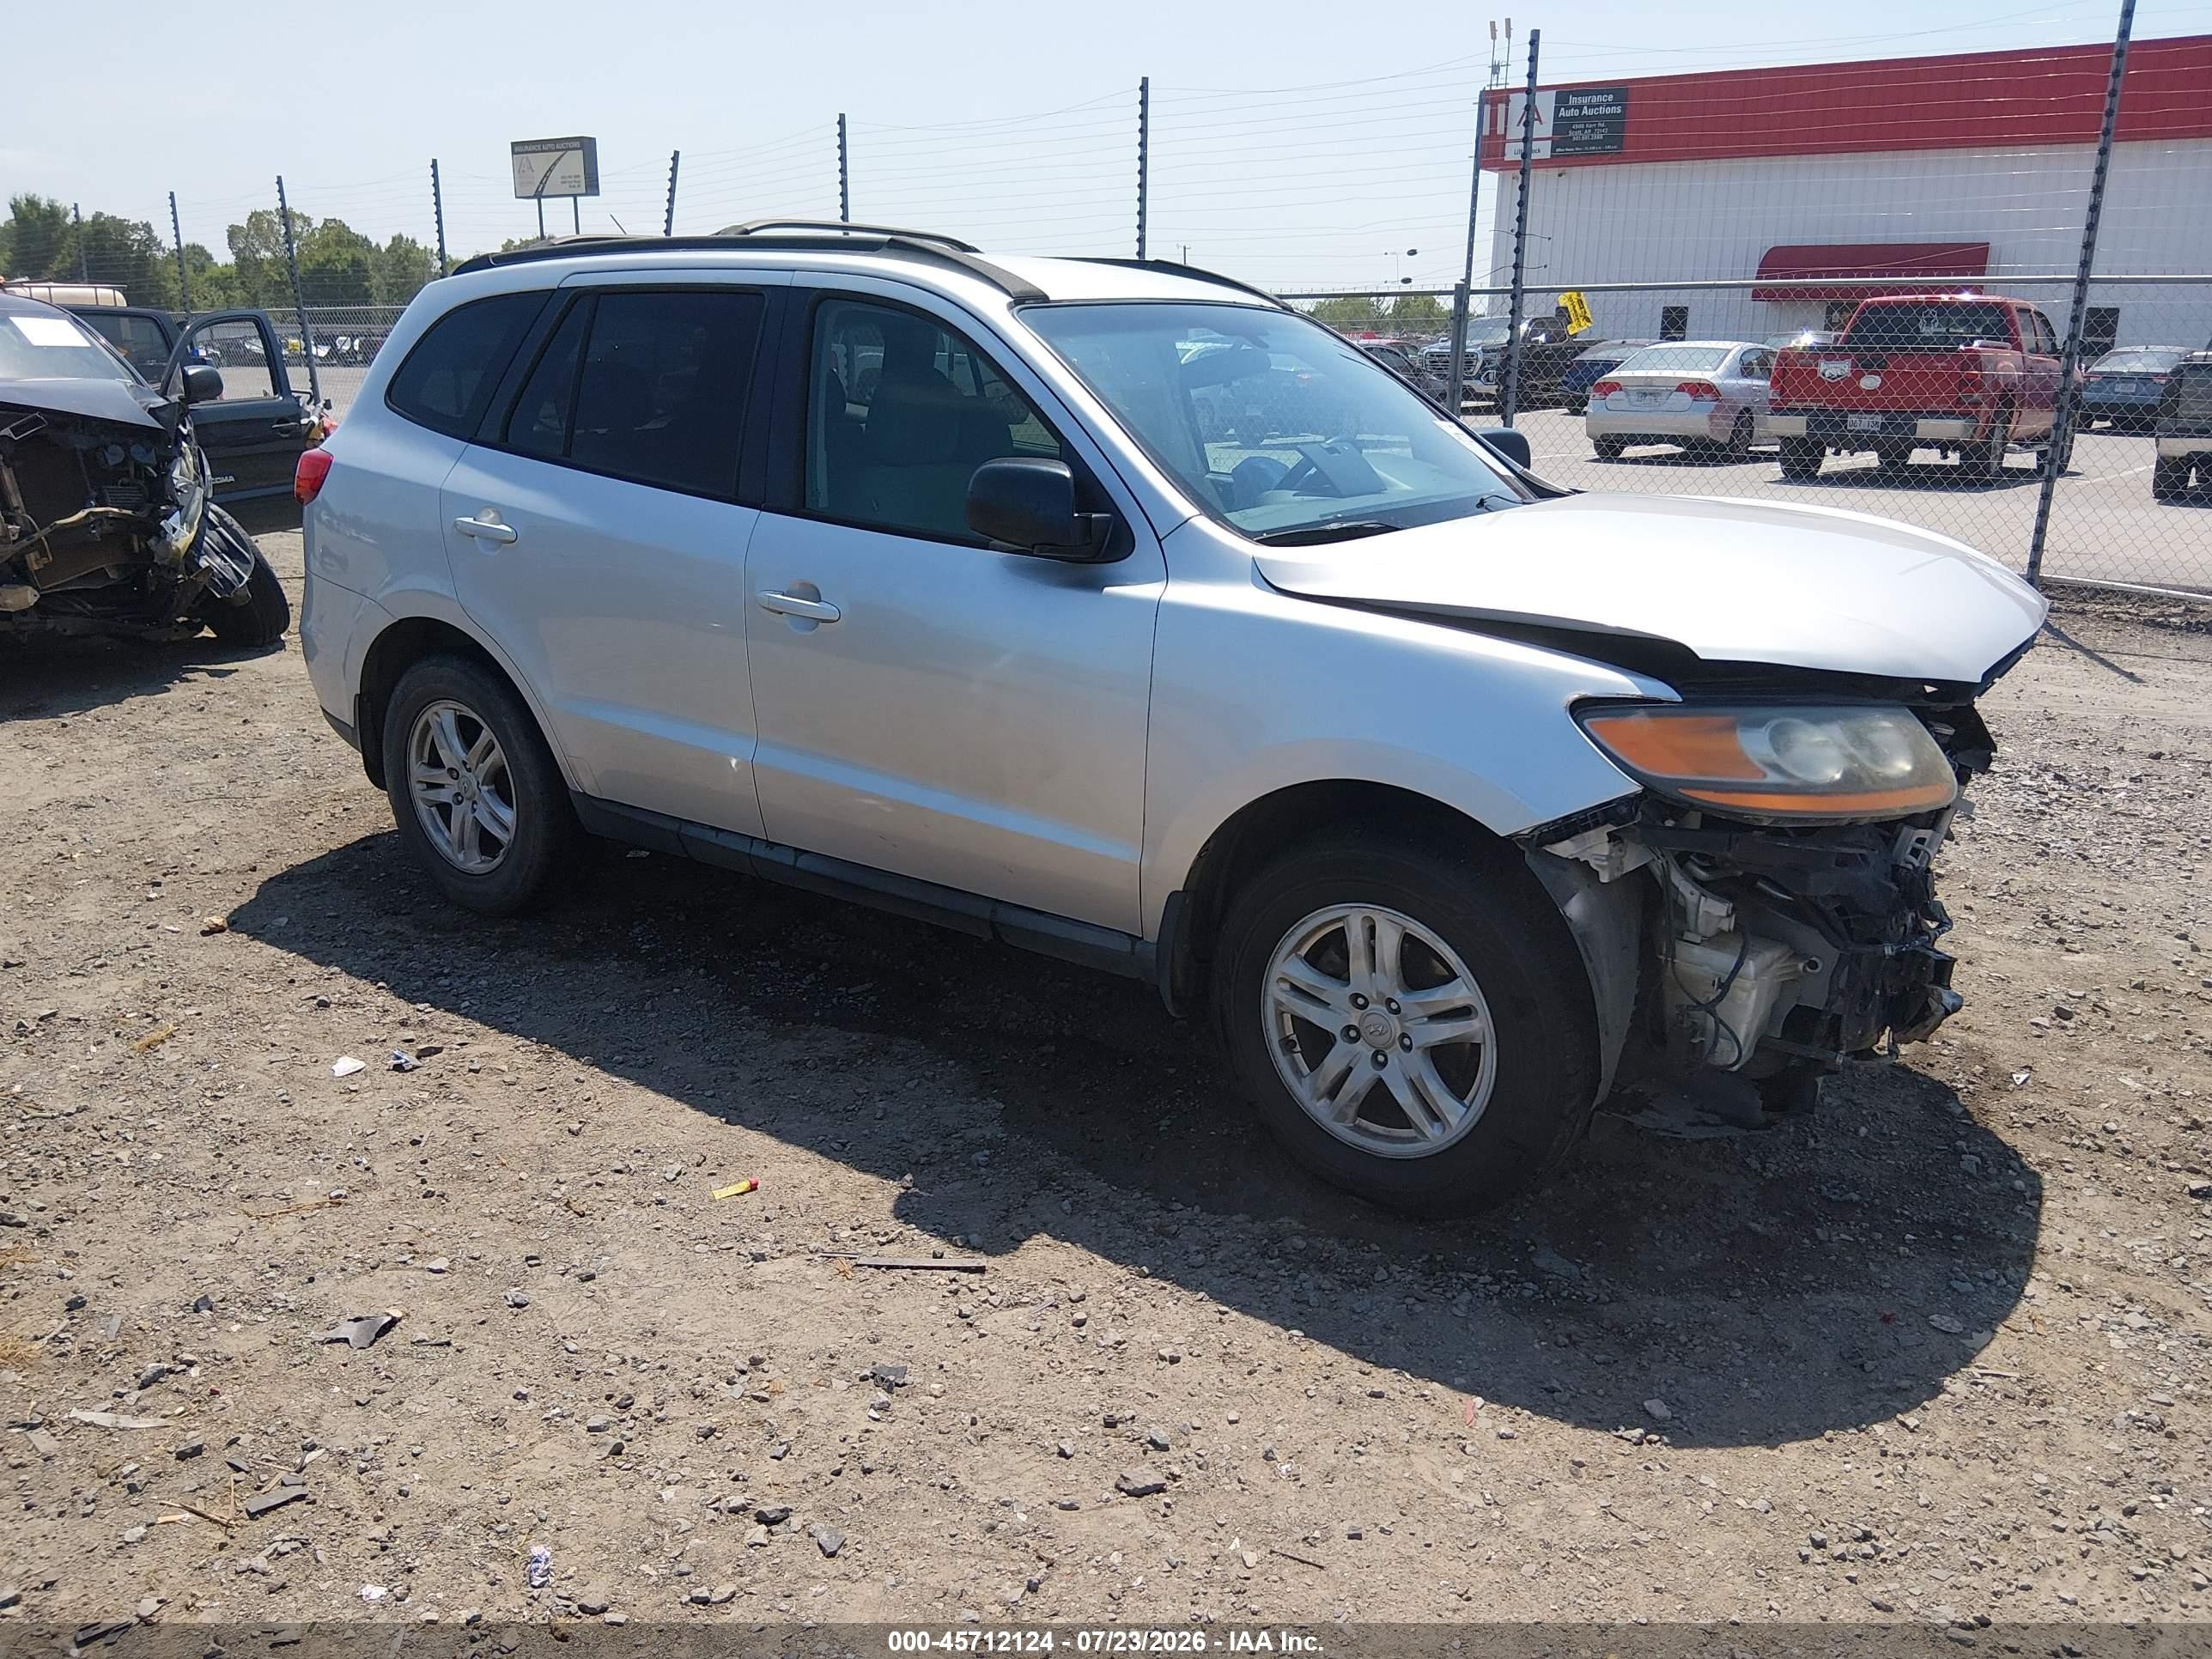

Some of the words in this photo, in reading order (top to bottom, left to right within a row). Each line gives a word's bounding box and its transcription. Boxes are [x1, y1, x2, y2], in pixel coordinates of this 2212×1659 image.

[1569, 94, 1613, 105] Insurance
[1559, 106, 1579, 118] Auto
[1581, 105, 1621, 116] Auctions
